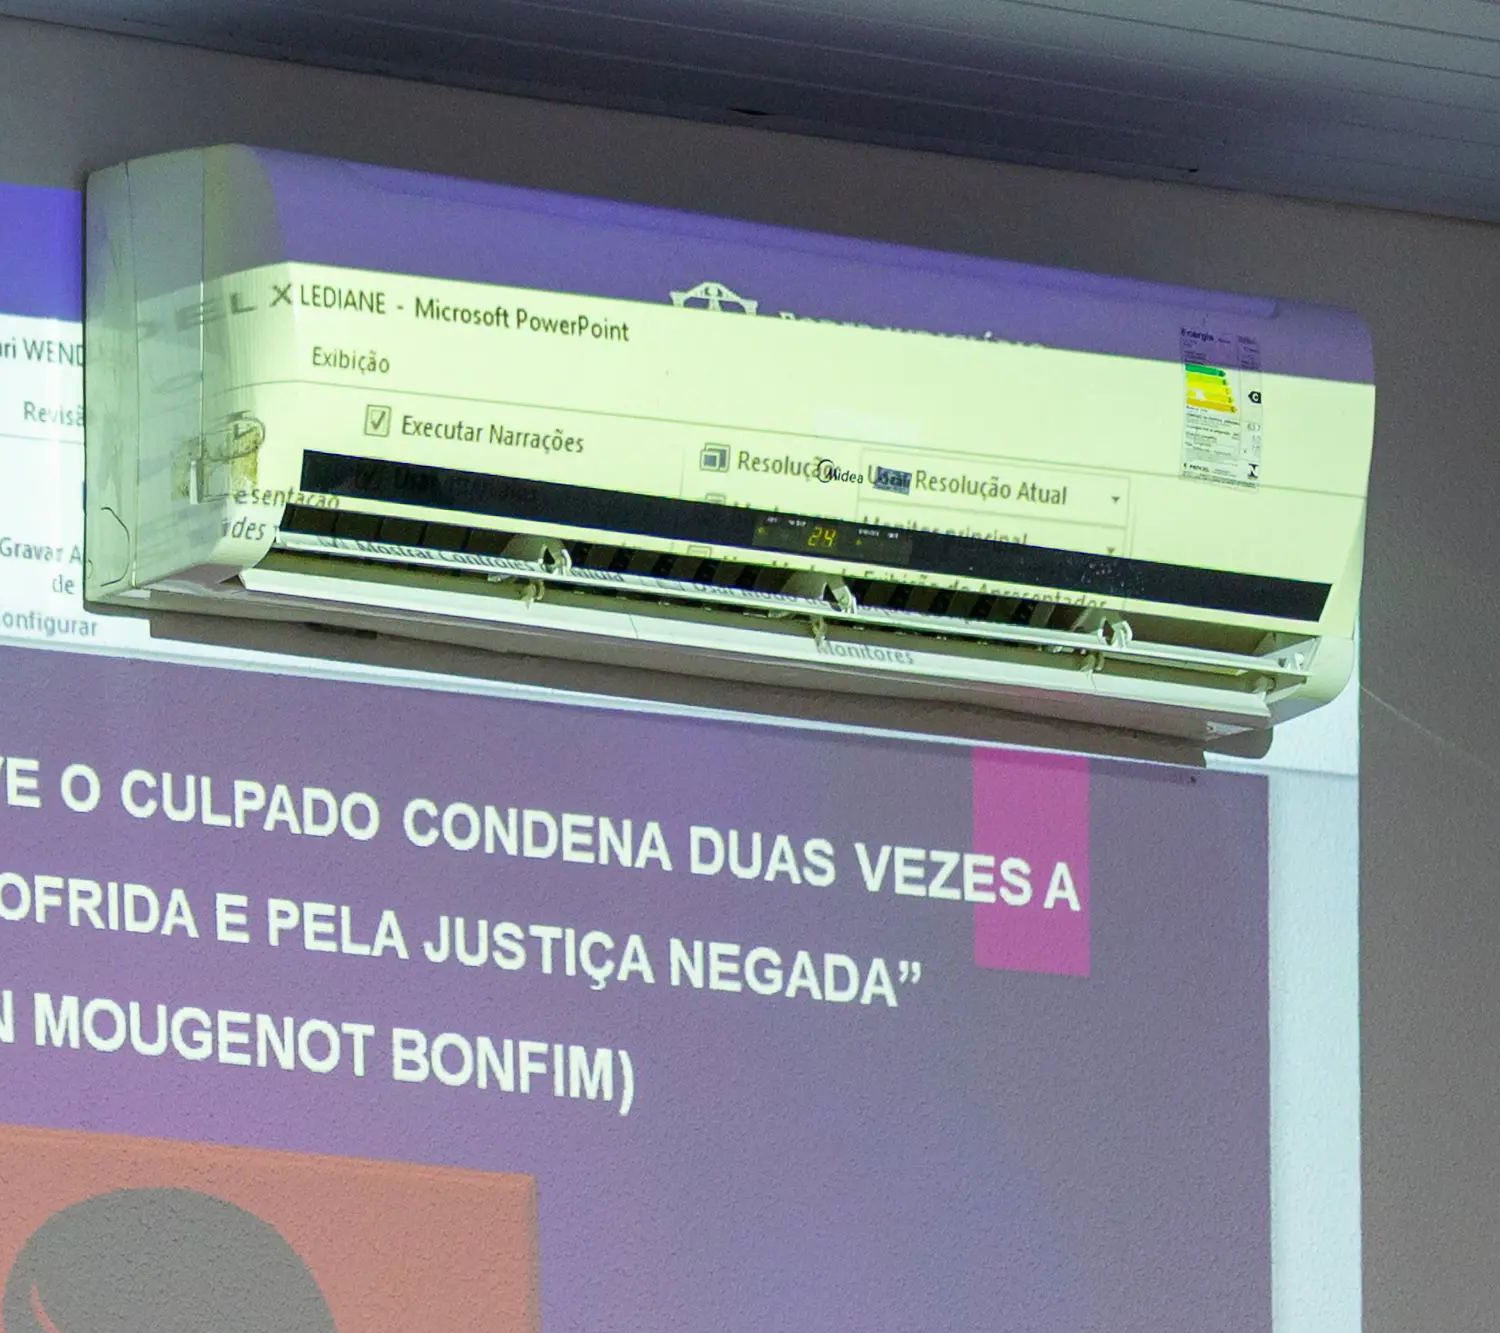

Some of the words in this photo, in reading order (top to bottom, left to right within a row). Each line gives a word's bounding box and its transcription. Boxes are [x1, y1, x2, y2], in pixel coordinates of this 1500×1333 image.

[299, 284, 386, 317] LEDIANE
[415, 296, 510, 330] Microsoft
[516, 311, 631, 343] PowerPoint
[312, 346, 391, 376] Exibição
[402, 414, 484, 446] Executar
[489, 423, 585, 456] Narrações
[817, 458, 864, 484] Midea
[915, 469, 1011, 500] Resolução
[1017, 482, 1068, 506] Atual
[807, 526, 837, 548] 24
[52, 573, 76, 595] de
[60, 762, 102, 813] O
[120, 767, 381, 844] CULPADO
[402, 797, 672, 874] CONDENA
[689, 825, 837, 888] DUAS
[854, 841, 1033, 908] VEZES
[1042, 861, 1082, 912] A
[214, 893, 250, 945] E
[267, 898, 410, 961] PELA
[424, 914, 656, 992] JUSTIÇA
[668, 936, 921, 1008] NEGADA”
[33, 993, 374, 1081] MOUGENOT
[390, 1025, 636, 1116] BONFIM)
